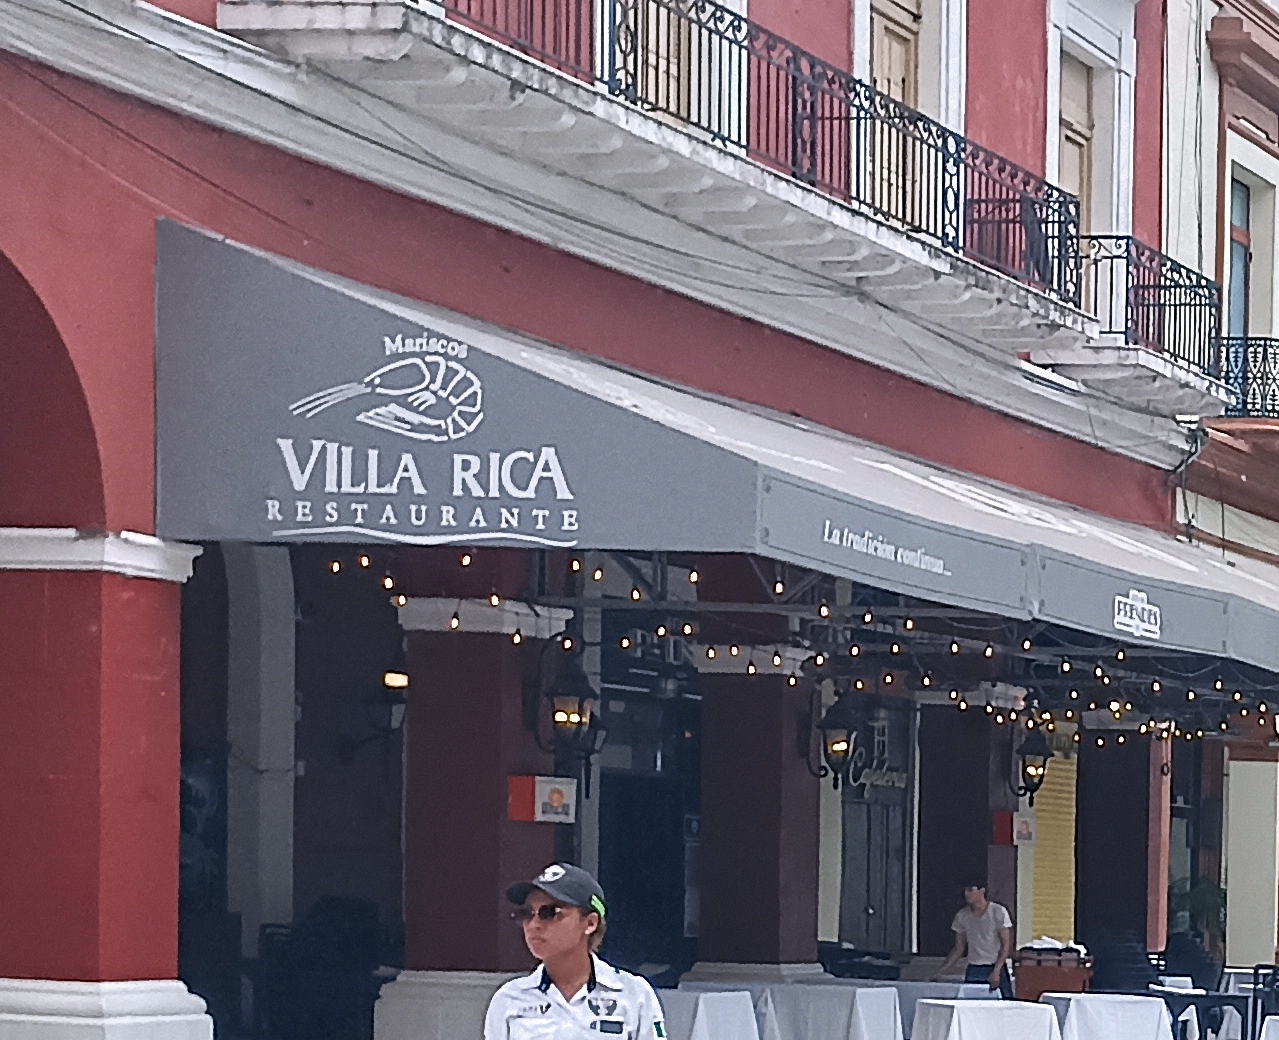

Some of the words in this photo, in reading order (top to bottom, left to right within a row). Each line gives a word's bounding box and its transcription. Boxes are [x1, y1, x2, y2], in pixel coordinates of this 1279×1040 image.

[383, 331, 469, 359] Mariscos
[276, 438, 427, 495] VILLA
[452, 445, 575, 500] RICA
[266, 499, 580, 531] RESTAURANTE
[823, 519, 841, 545] La
